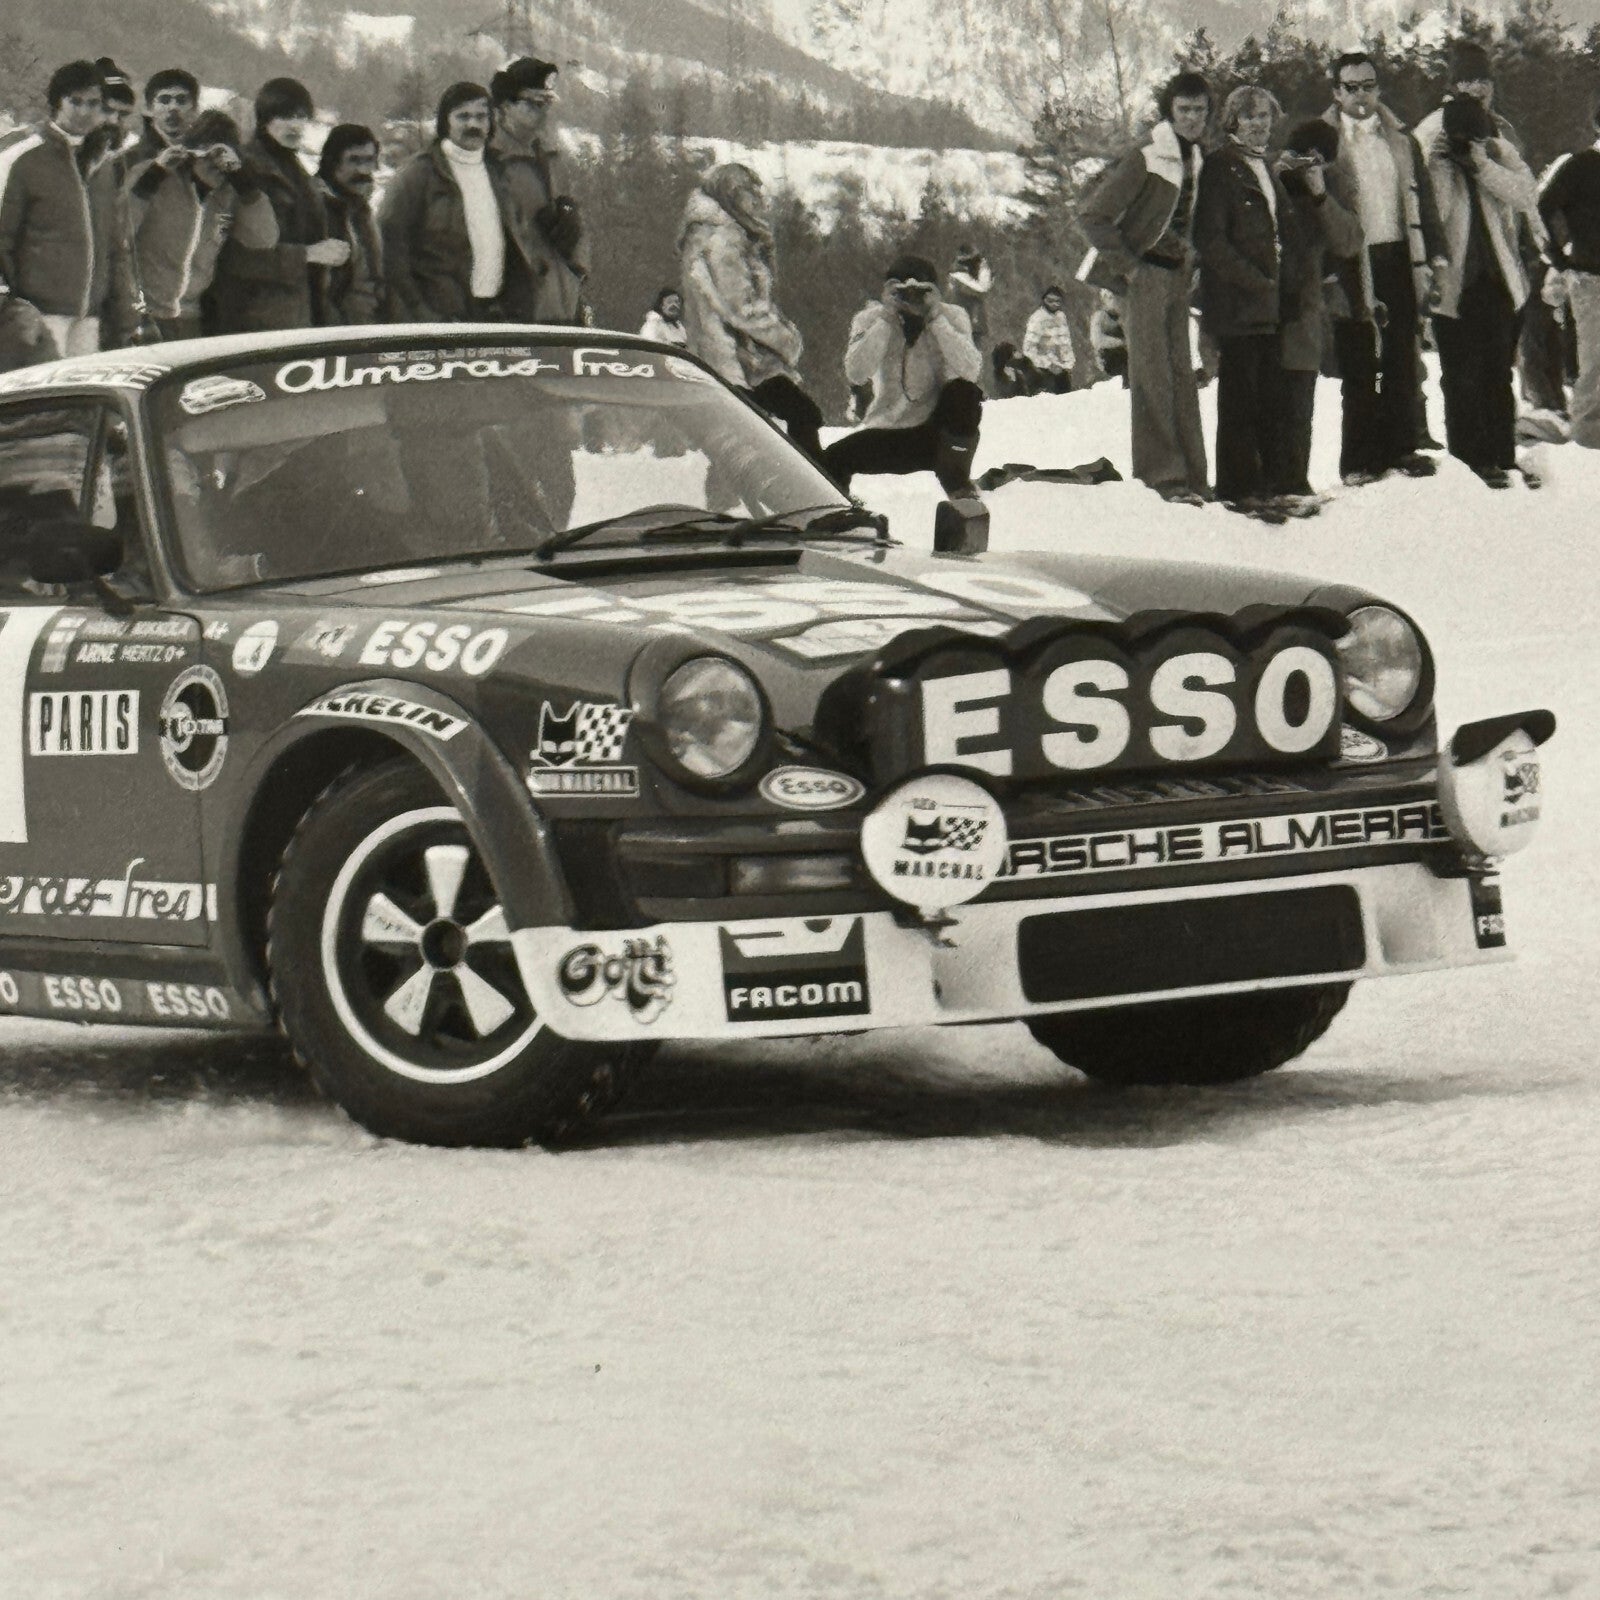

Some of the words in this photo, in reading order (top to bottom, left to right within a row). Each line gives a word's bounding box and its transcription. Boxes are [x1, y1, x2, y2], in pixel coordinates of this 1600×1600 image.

[573, 347, 655, 378] Fres
[358, 619, 510, 676] ESSO
[40, 693, 130, 752] PARIS
[921, 645, 1337, 777] ESSO
[777, 777, 848, 795] ESSO
[893, 859, 984, 881] MARCHAL
[43, 975, 123, 1013] ESSO
[146, 981, 231, 1020] ESSO
[729, 980, 863, 1010] FACOM
